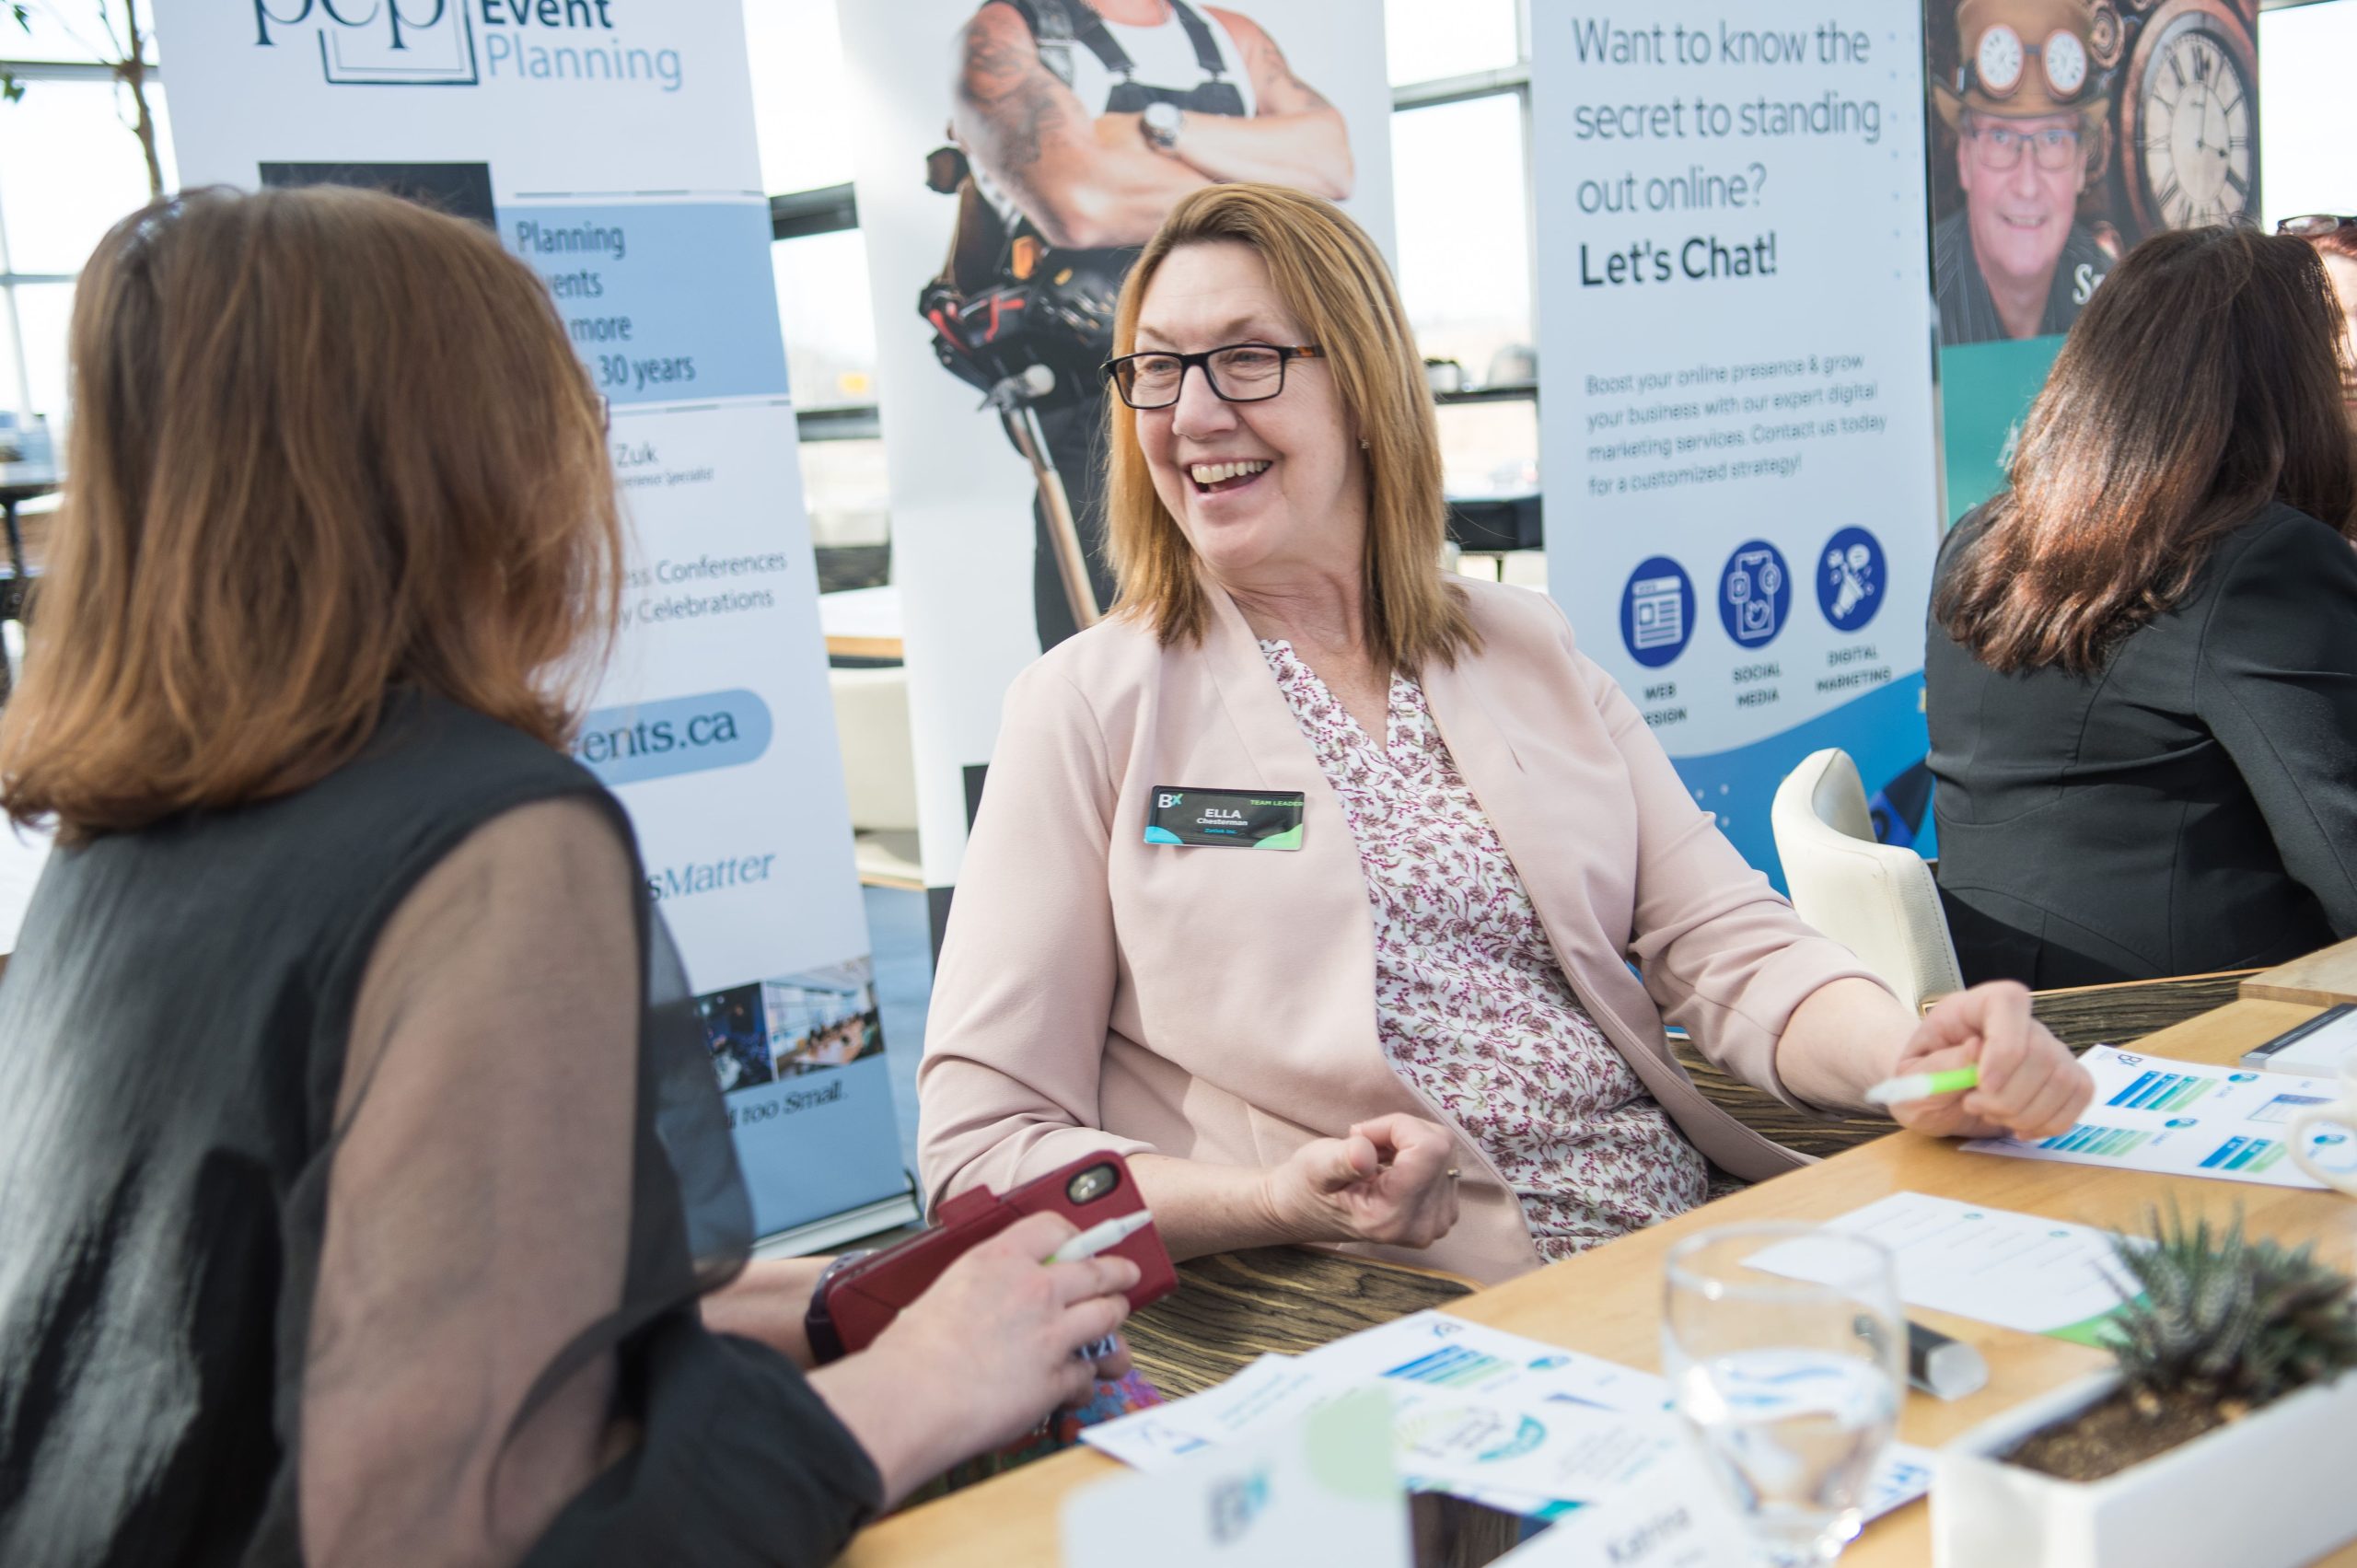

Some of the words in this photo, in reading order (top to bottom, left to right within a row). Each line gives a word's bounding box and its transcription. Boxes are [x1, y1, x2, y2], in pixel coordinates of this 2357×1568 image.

[1573, 18, 1667, 64] Want
[1675, 24, 1712, 64] to
[1720, 20, 1806, 64] know
[1816, 20, 1871, 64] the
[485, 31, 682, 93] Planning
[1573, 96, 1687, 140] secret
[1694, 95, 1732, 137] to
[1739, 89, 1881, 145] standing
[1576, 170, 1638, 215] out
[1645, 162, 1768, 212] online?
[516, 220, 627, 261] Planning
[1580, 239, 1673, 287] Let's
[1681, 230, 1778, 280] Chat!
[551, 269, 604, 299] ents
[570, 316, 633, 343] more
[598, 354, 630, 387] 30
[632, 356, 697, 392] years
[1585, 374, 1634, 396] Boost
[1637, 376, 1672, 395] your
[1678, 365, 1729, 388] online
[1731, 359, 1805, 385] presence
[1823, 354, 1865, 378] grow
[1586, 412, 1623, 434] your
[1628, 401, 1701, 426] business
[1704, 396, 1740, 416] with
[1743, 396, 1771, 414] our
[1773, 389, 1824, 412] expert
[1828, 382, 1878, 406] digital
[1586, 436, 1673, 462] marketing
[1751, 421, 1816, 445] Contact
[1819, 420, 1838, 436] us
[1840, 413, 1888, 436] today
[1587, 476, 1613, 498] for
[1616, 477, 1628, 494] a
[1631, 462, 1728, 493] customized
[1730, 453, 1803, 481] strategy!
[656, 551, 789, 586] Conferences
[637, 589, 775, 624] Celebrations
[1732, 663, 1782, 684] SOCIAL
[1827, 645, 1879, 668] DIGITAL
[1643, 682, 1678, 703] WEB
[1815, 667, 1892, 693] MARKETING
[1736, 688, 1780, 709] MEDIA
[1644, 707, 1688, 727] ESIGN
[582, 710, 739, 764] ents.ca
[1204, 807, 1242, 819] ELLA
[1249, 798, 1272, 807] TEAM
[1272, 799, 1305, 807] LEADER
[1196, 817, 1248, 827] Chesterman
[646, 853, 776, 901] sMatter
[742, 1099, 780, 1125] too
